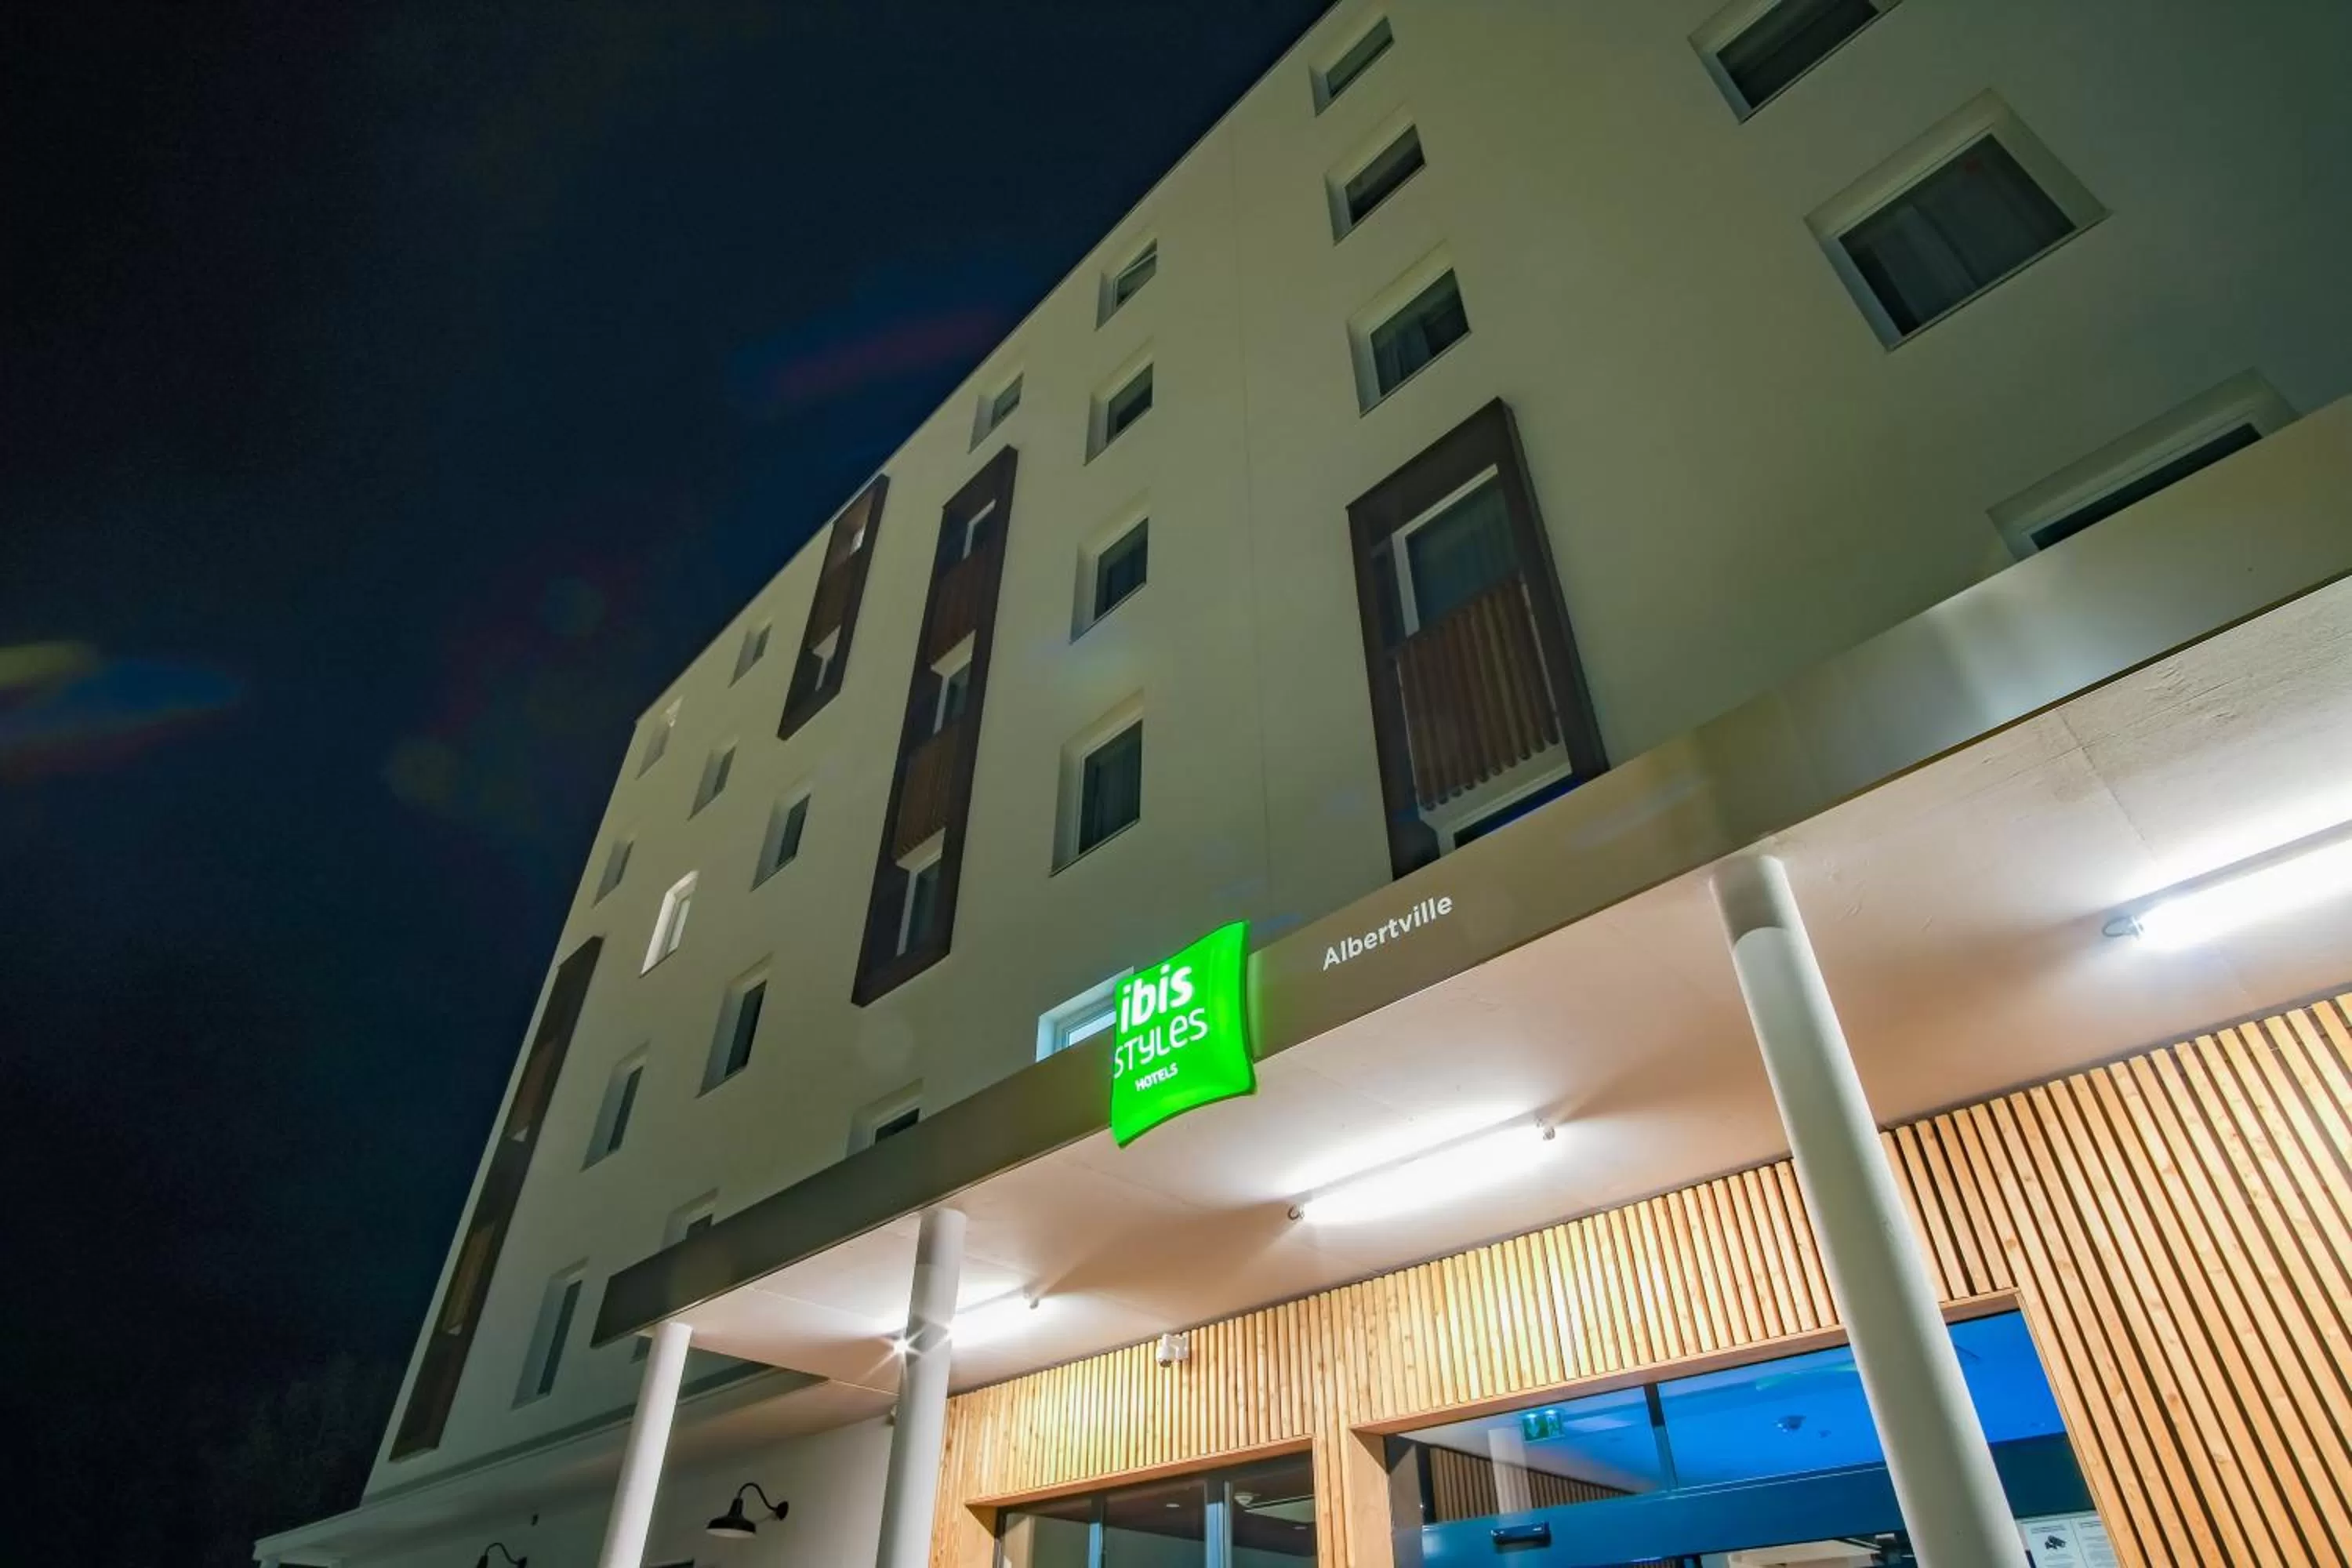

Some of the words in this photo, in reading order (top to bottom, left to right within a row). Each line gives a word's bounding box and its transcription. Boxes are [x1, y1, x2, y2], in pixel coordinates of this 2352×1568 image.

[1322, 895, 1454, 971] Albertville
[1120, 964, 1195, 1034] ibis
[1134, 1062, 1179, 1092] HOTELS
